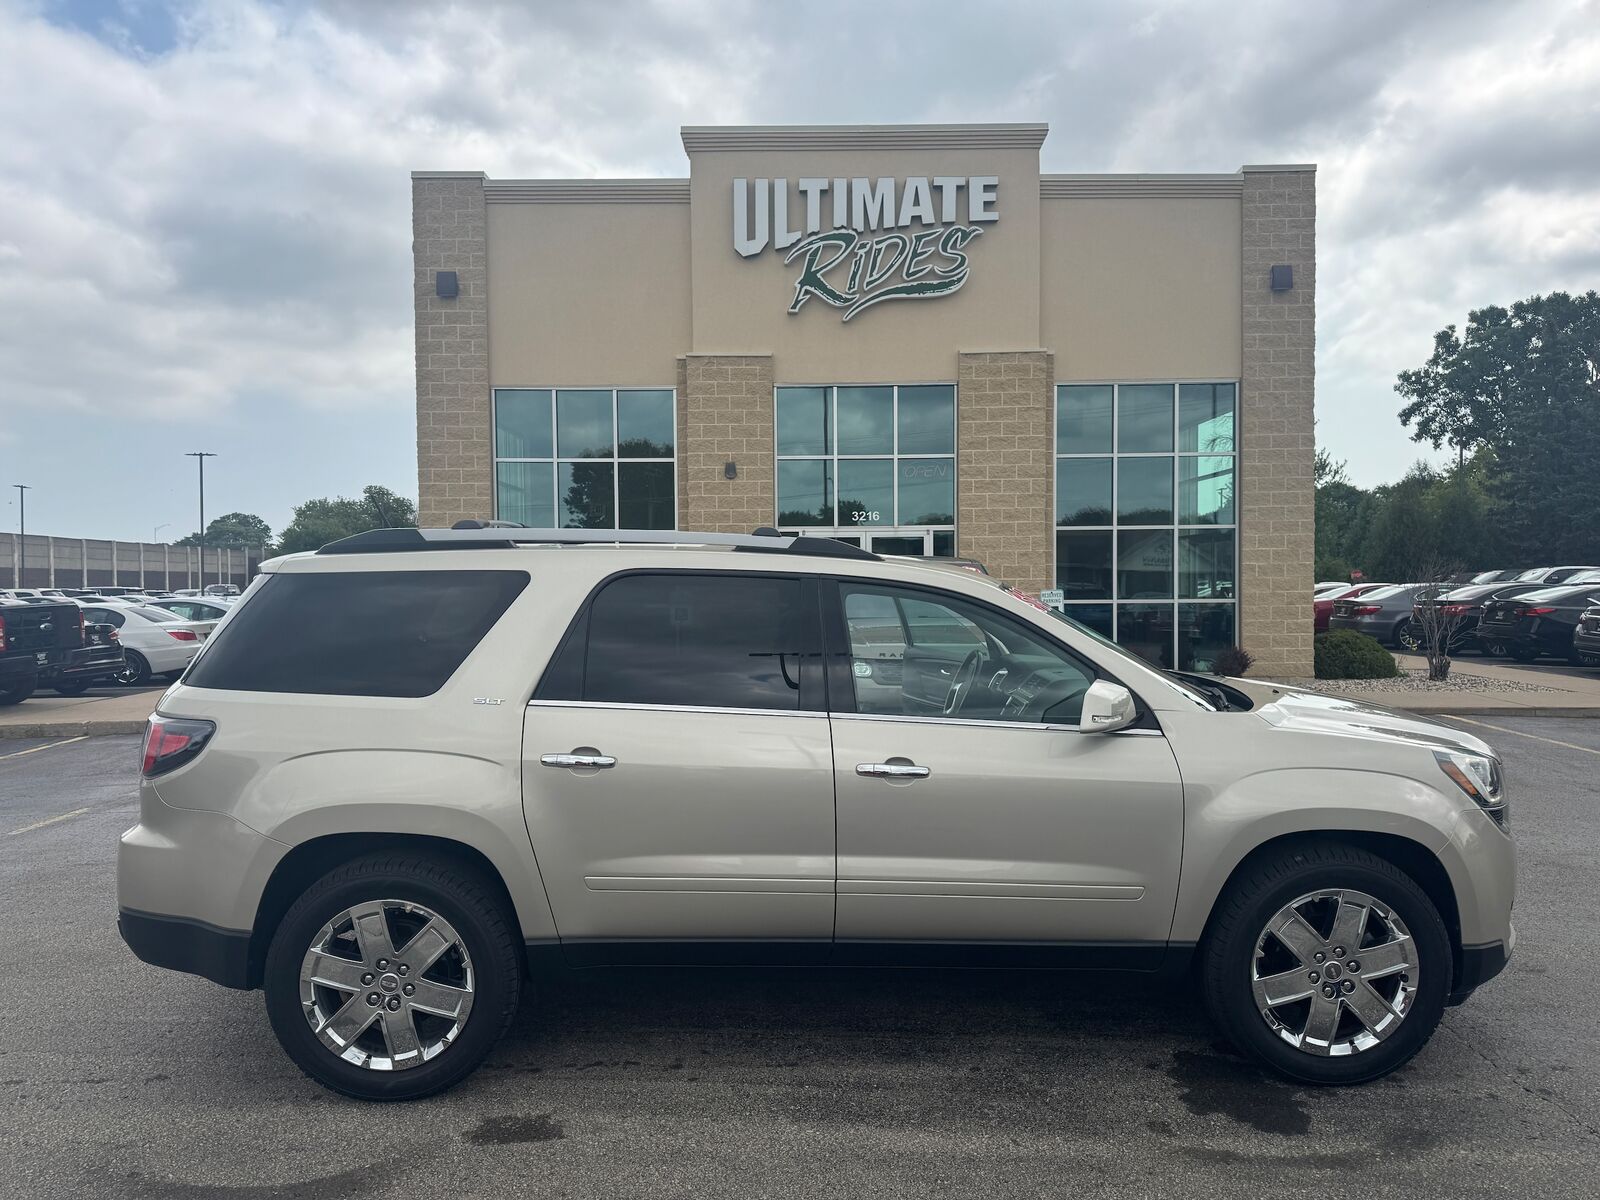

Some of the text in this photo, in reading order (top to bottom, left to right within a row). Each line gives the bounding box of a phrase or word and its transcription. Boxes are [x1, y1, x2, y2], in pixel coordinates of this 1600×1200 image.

[732, 176, 1000, 258] ULTIMATE
[904, 464, 946, 478] OPEN
[851, 511, 880, 521] 3216
[473, 697, 505, 705] SLT
